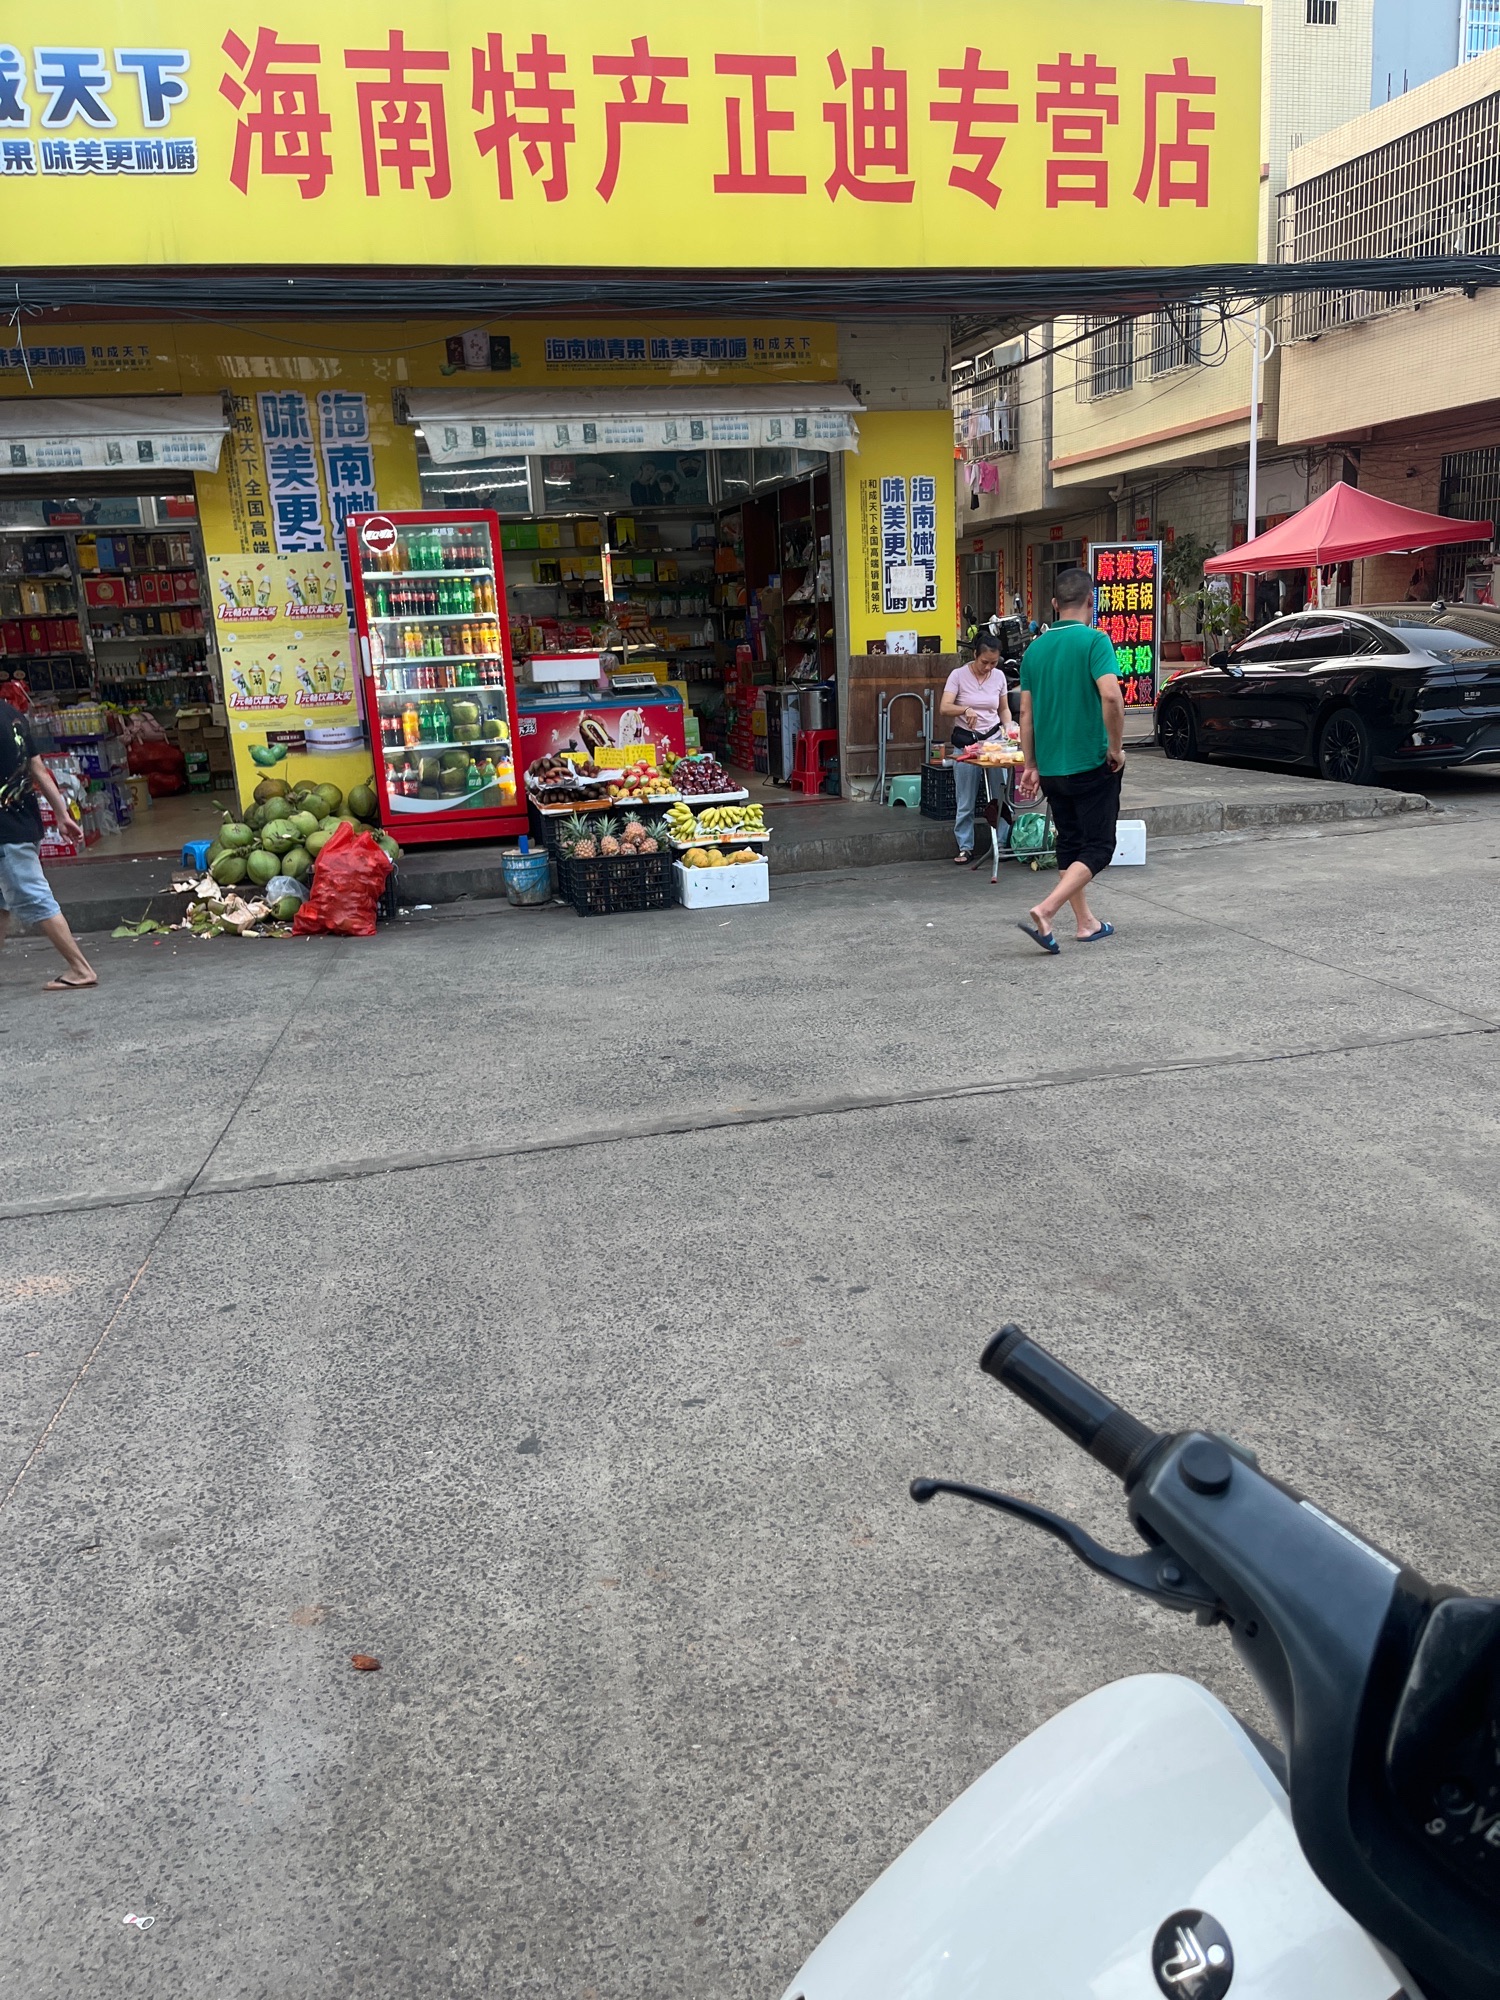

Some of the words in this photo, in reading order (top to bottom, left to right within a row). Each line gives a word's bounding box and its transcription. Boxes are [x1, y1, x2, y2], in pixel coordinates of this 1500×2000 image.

[221, 27, 1215, 209] 海南特产正迪专营店
[42, 141, 195, 171] 味美更耐嚼
[91, 345, 149, 357] 和成天下
[546, 338, 646, 360] 海南嫩青果
[650, 338, 747, 360] 味美更耐嚼
[753, 337, 811, 351] 和成天下
[262, 393, 325, 553] 味美更
[868, 479, 880, 613] 和成天下全国高端销量领先
[1096, 550, 1154, 581] 麻辣烫
[1097, 582, 1153, 612] 麻辣香锅
[1097, 614, 1153, 643] 米粉冷面
